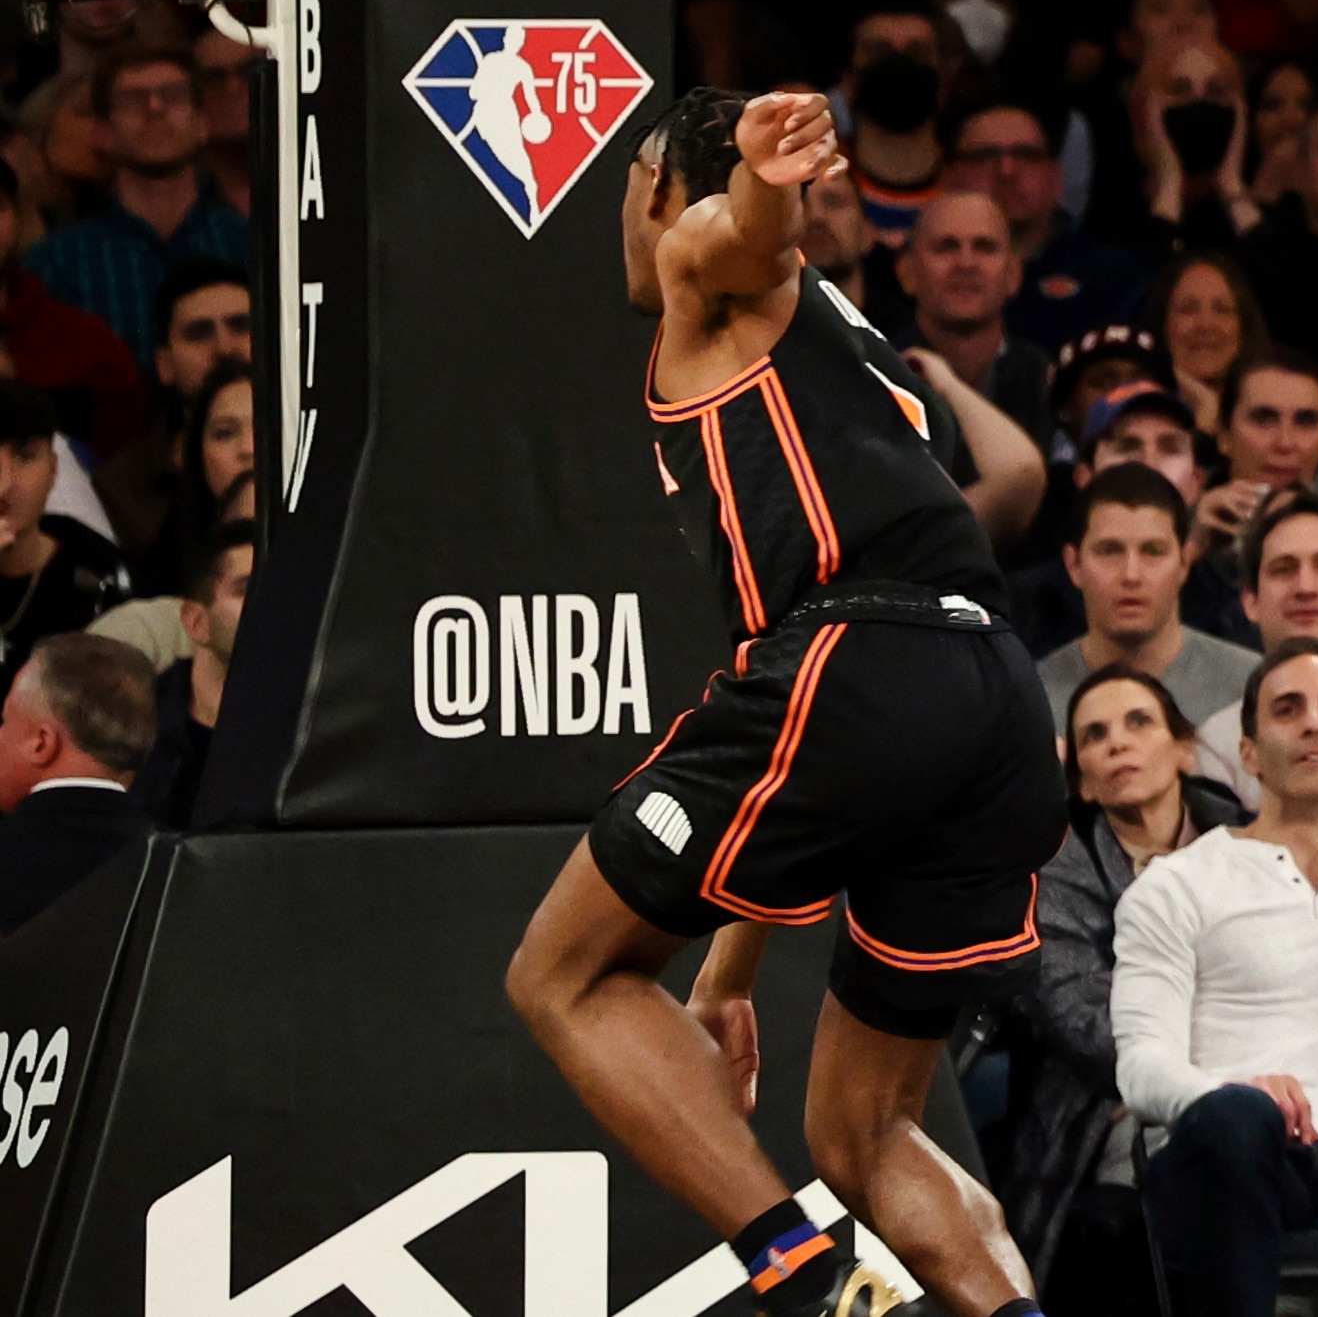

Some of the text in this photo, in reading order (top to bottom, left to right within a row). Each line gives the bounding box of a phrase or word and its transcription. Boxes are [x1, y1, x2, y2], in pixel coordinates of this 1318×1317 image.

[551, 51, 598, 116] 75
[412, 592, 653, 740] @NBA
[0, 1025, 70, 1169] se
